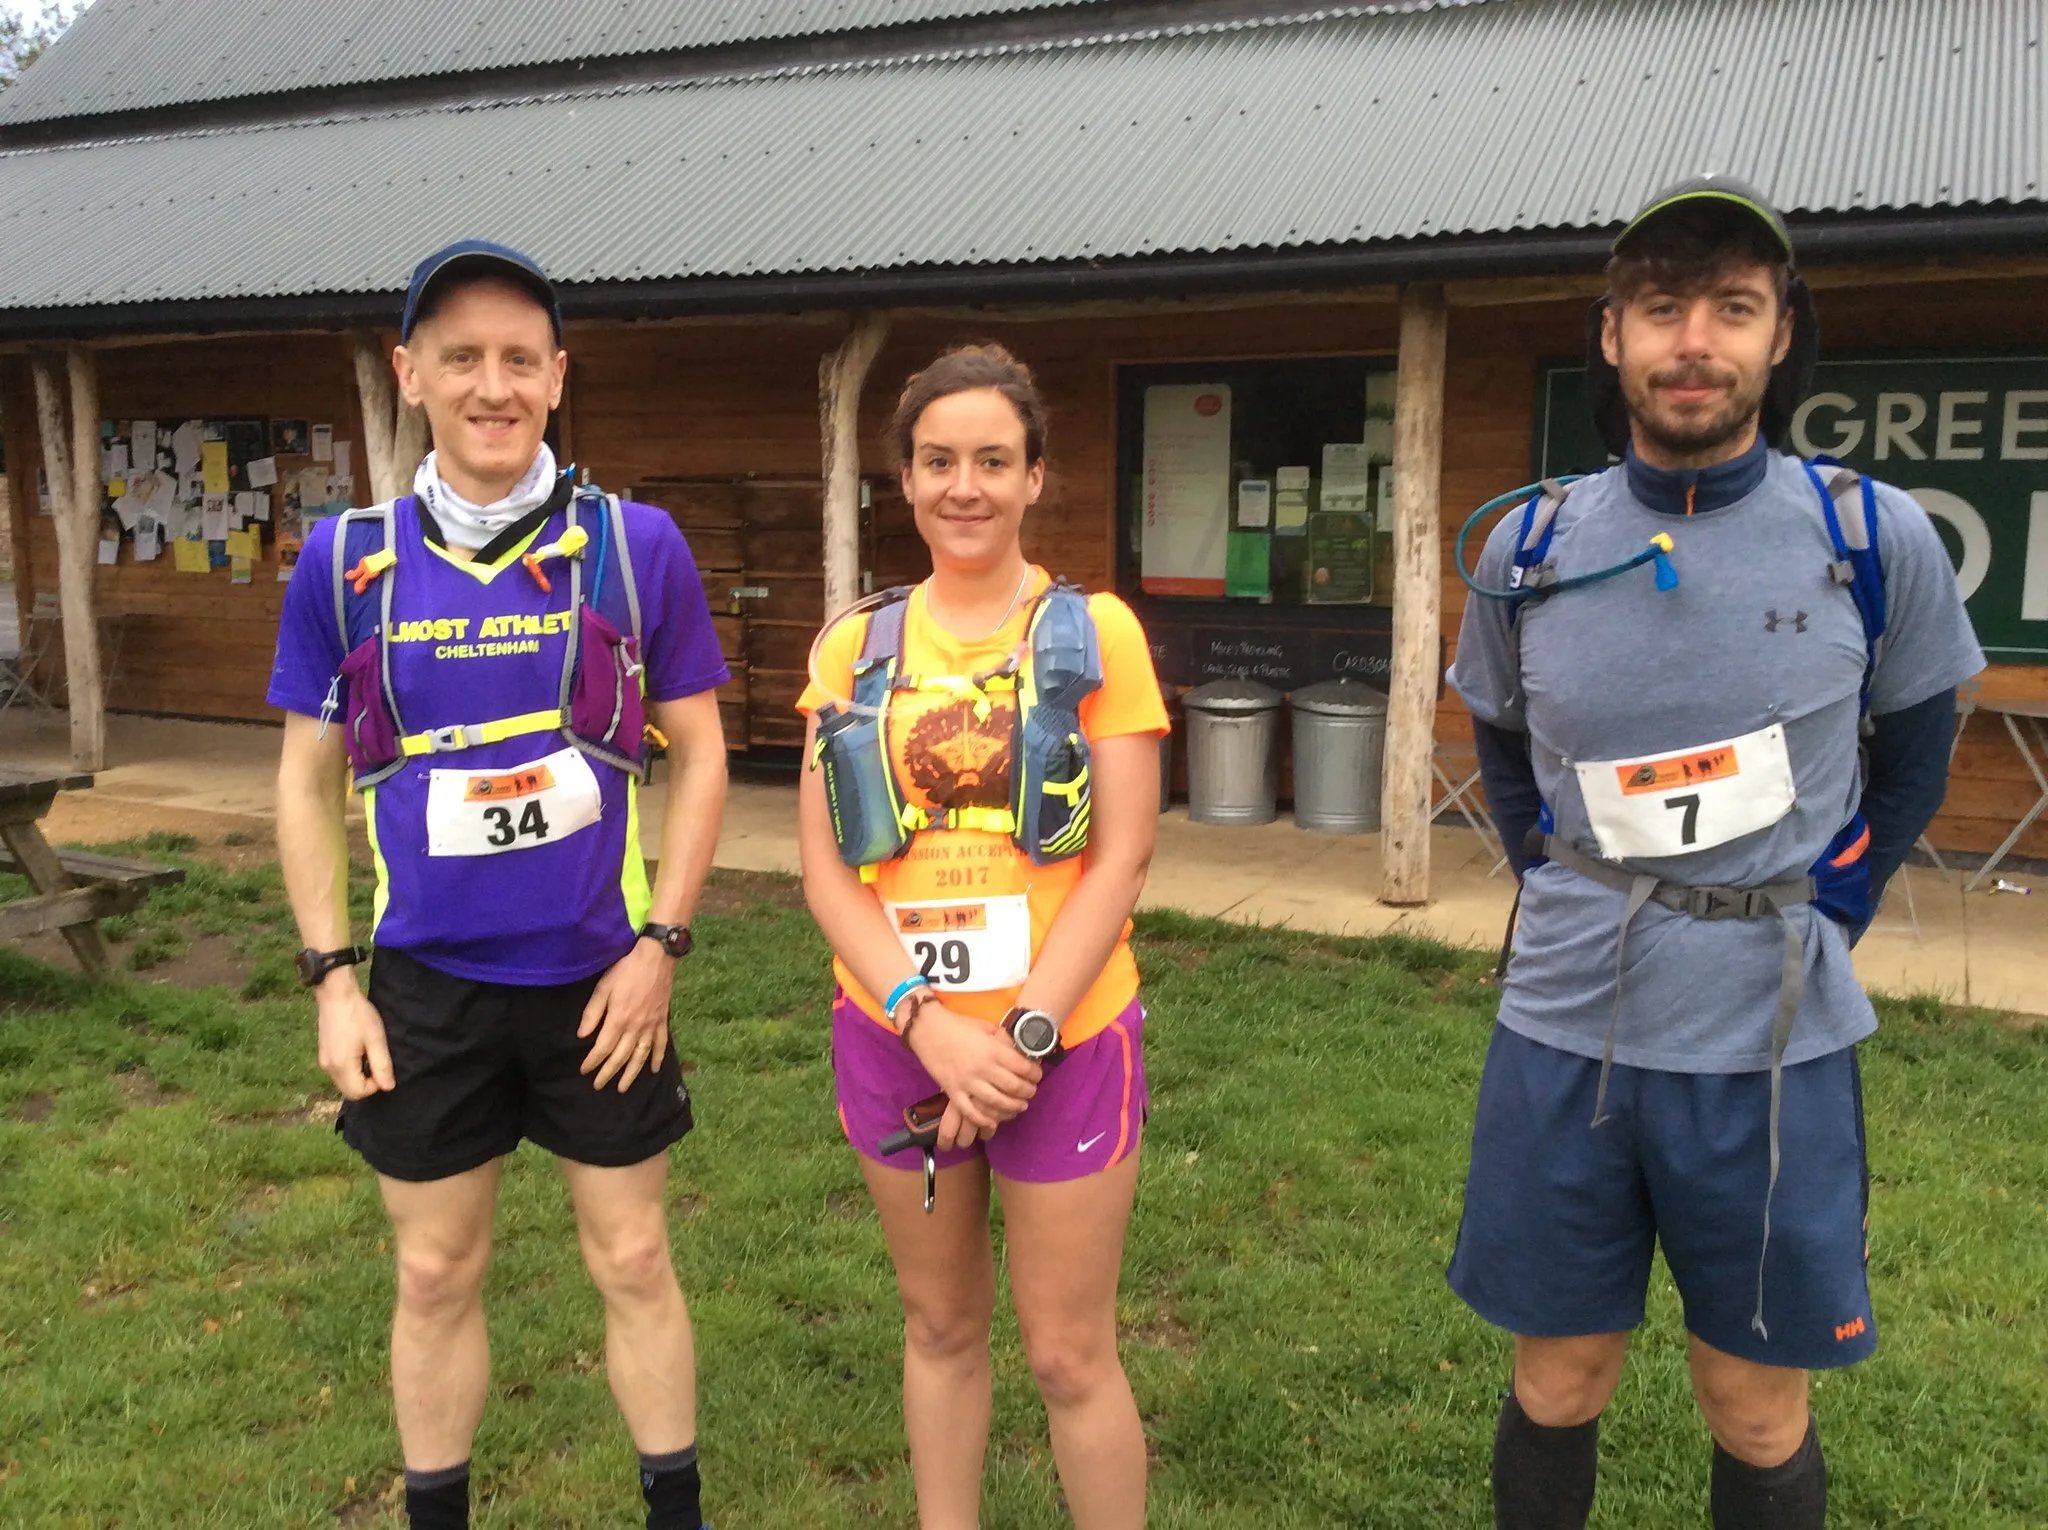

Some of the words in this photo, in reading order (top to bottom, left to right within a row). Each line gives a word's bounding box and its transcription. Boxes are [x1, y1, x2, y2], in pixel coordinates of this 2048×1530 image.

[1790, 389, 2048, 460] GREE
[388, 618, 470, 643] LMOST
[478, 610, 572, 639] ATHLET
[434, 639, 540, 660] CHELTENHAM
[483, 799, 549, 846] 34
[1664, 793, 1700, 846] 7
[935, 866, 990, 887] 2017
[914, 940, 970, 984] 29
